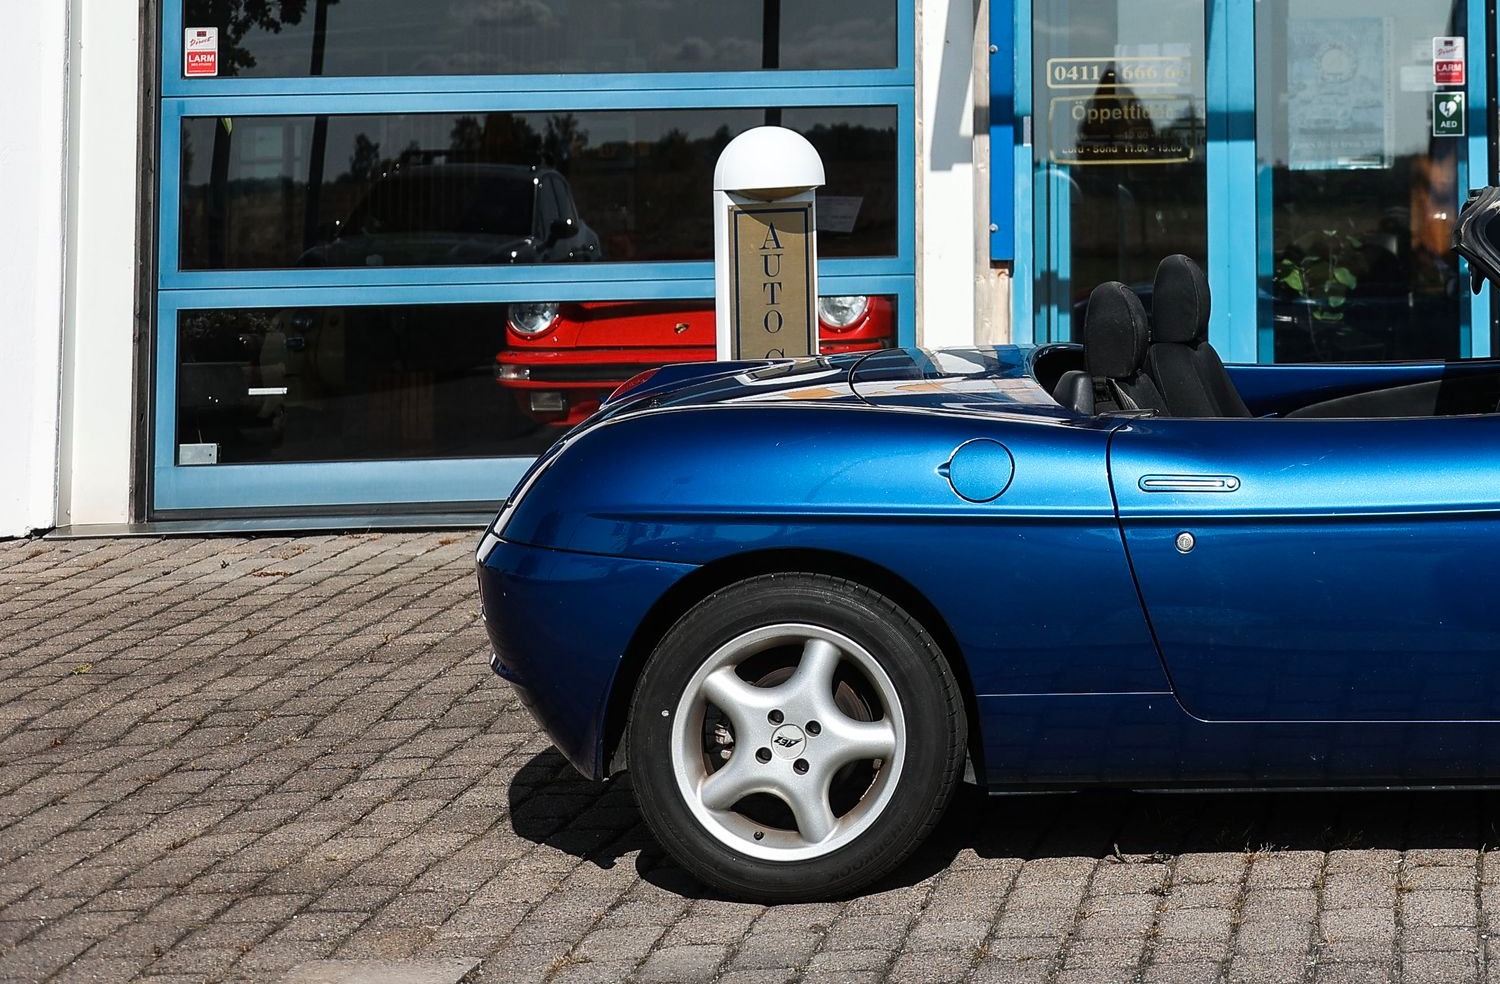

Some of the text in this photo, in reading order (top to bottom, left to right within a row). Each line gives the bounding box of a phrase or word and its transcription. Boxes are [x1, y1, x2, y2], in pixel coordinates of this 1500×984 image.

[188, 54, 215, 62] LARM
[1436, 63, 1462, 72] LARM
[1054, 65, 1101, 81] 0411
[1440, 120, 1458, 128] AED
[759, 221, 785, 334] AUTO
